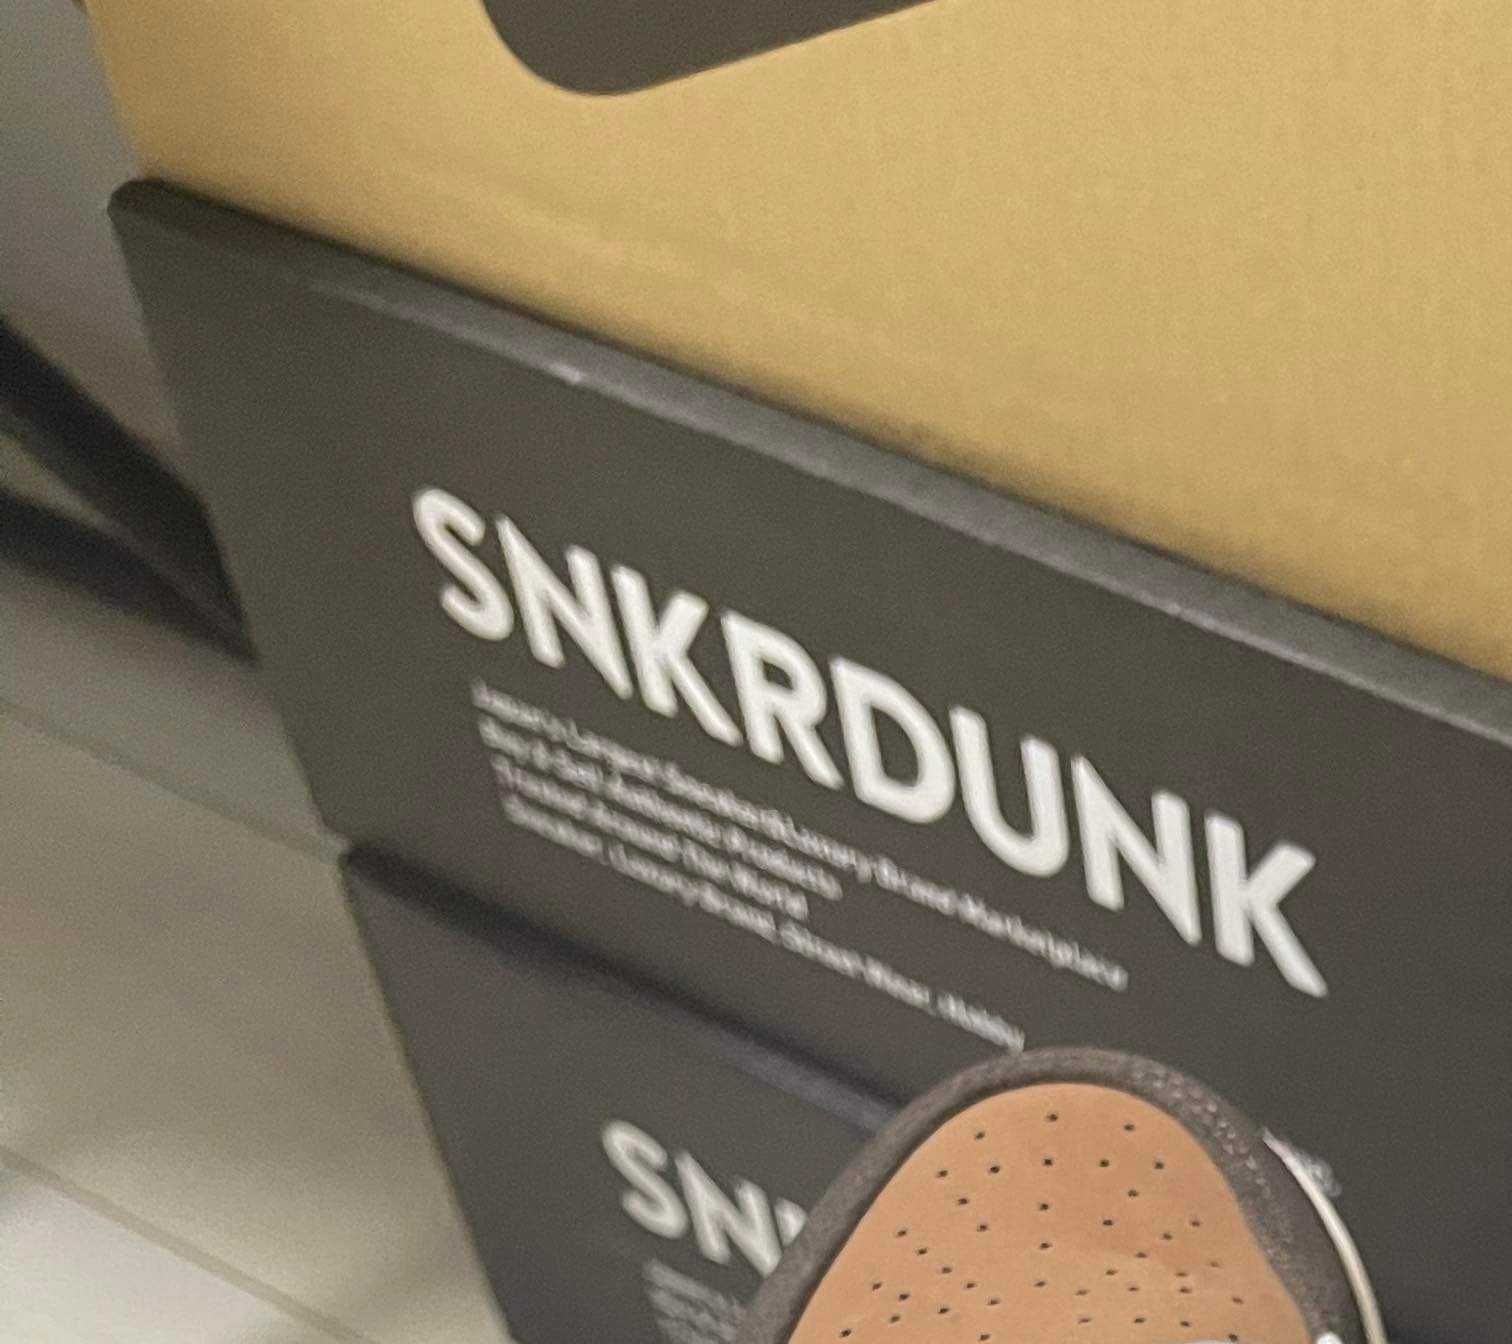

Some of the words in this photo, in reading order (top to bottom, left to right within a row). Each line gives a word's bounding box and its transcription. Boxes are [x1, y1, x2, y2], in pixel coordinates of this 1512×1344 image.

[414, 490, 1329, 996] SNKRDUNK
[731, 863, 808, 919] World
[601, 1119, 808, 1280] SN
